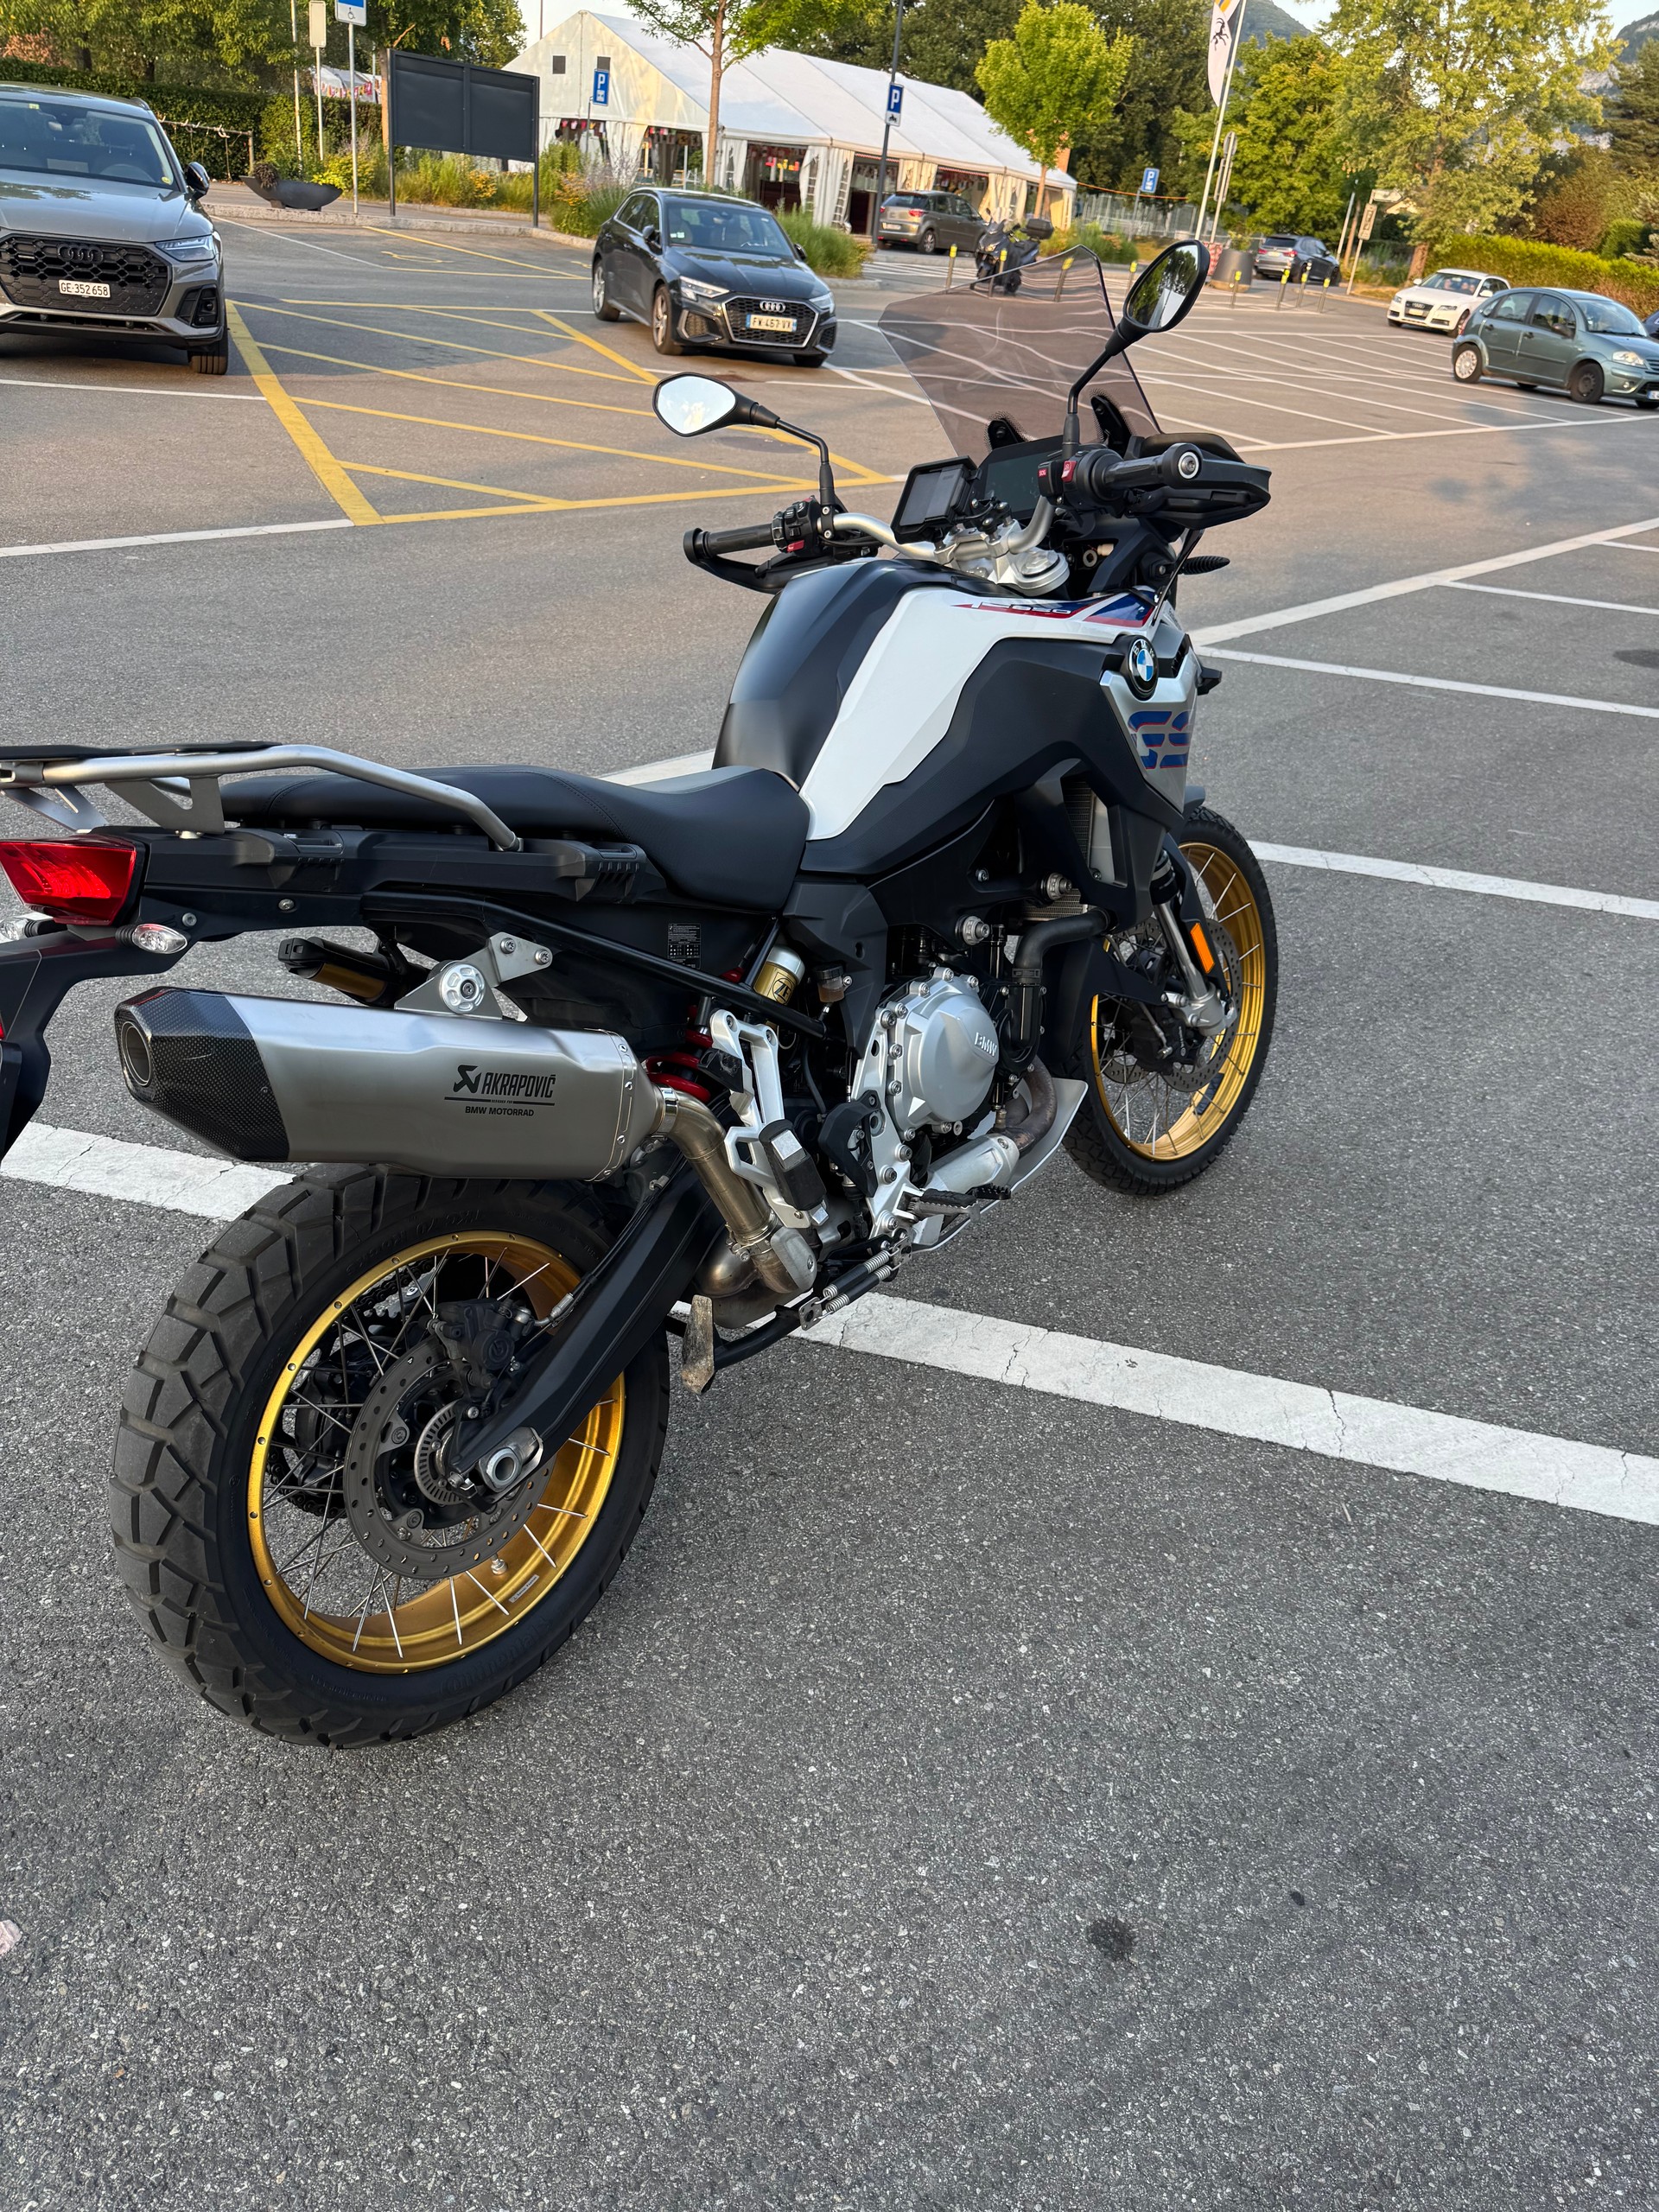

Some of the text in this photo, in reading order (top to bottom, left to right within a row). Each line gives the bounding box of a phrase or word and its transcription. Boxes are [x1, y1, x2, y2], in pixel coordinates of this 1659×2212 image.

[597, 73, 606, 89] P
[891, 89, 900, 110] P
[1147, 171, 1155, 181] P
[974, 1032, 997, 1057] BMW
[465, 1106, 535, 1117] BMW MOTORRAD
